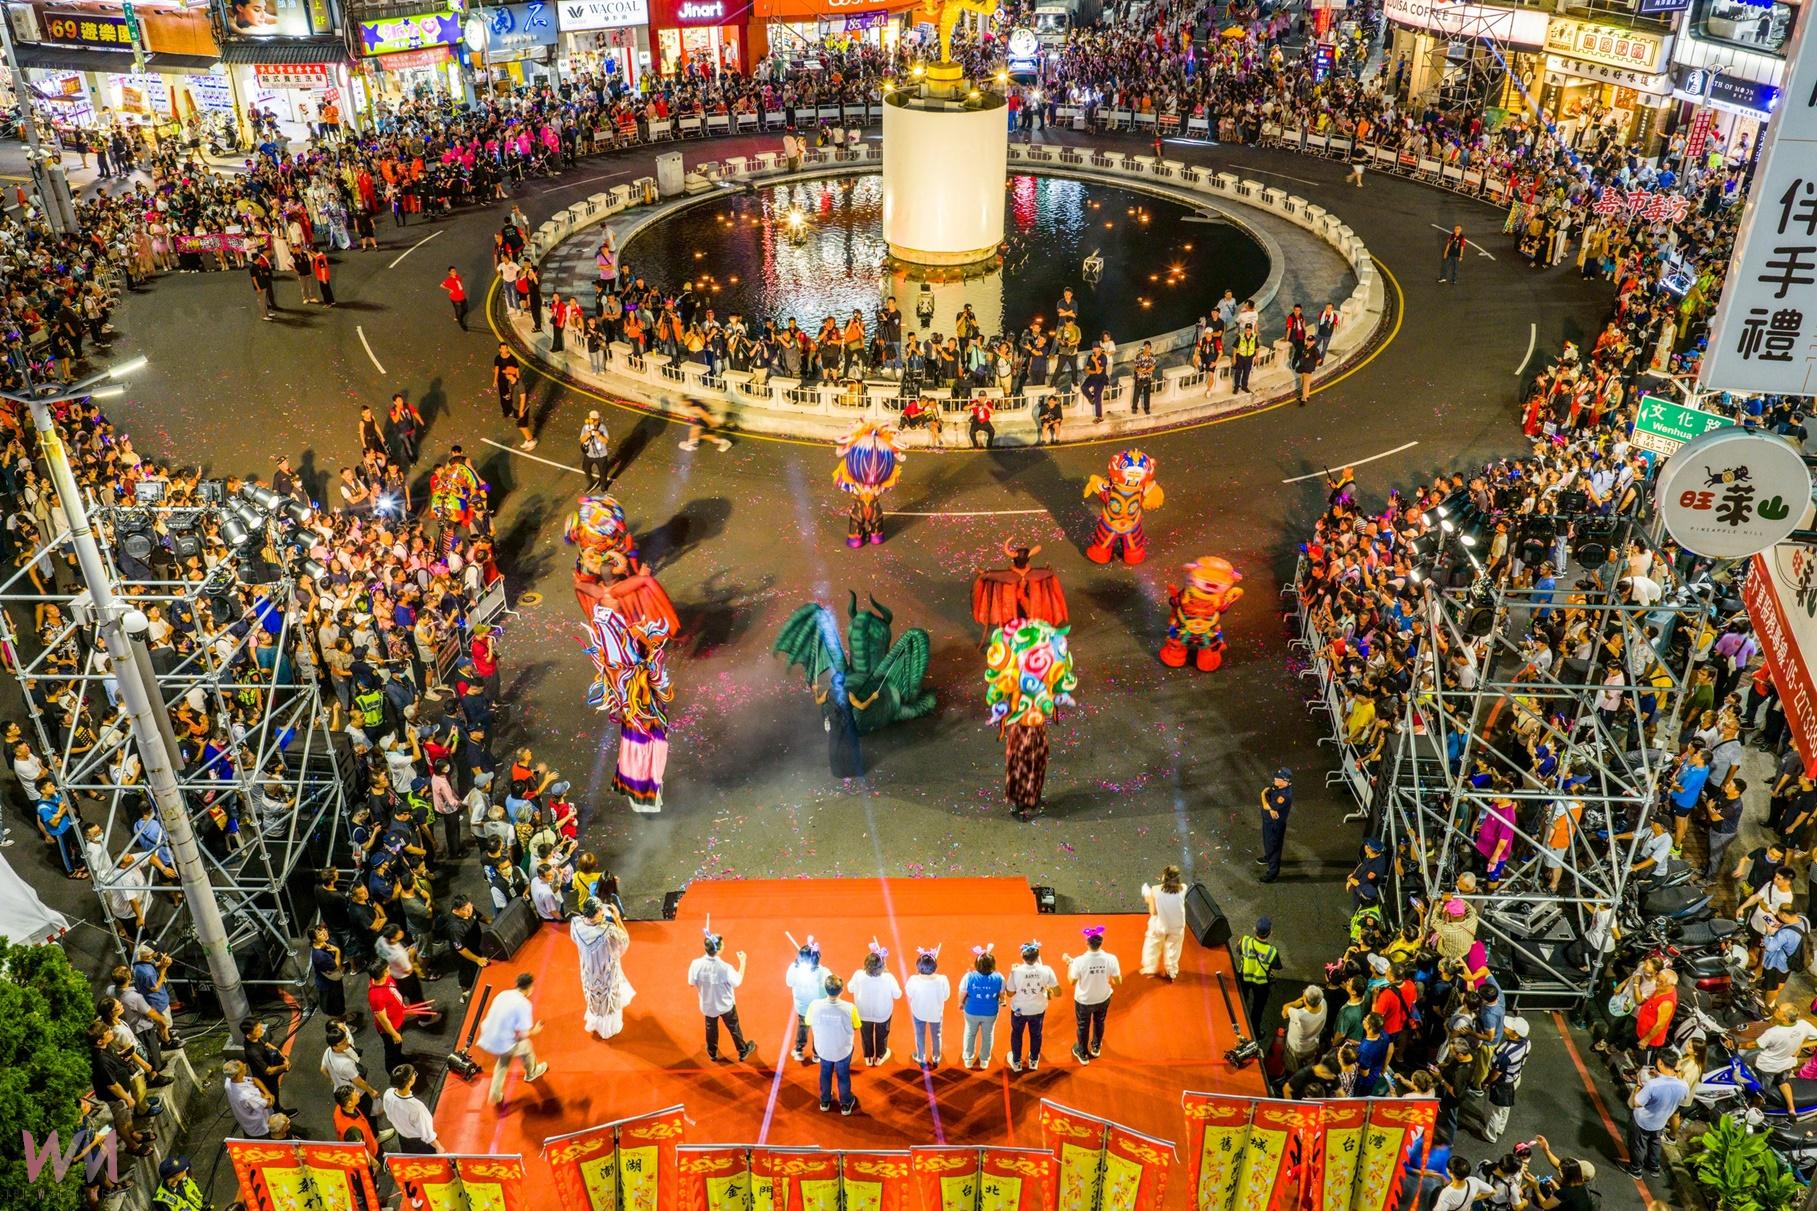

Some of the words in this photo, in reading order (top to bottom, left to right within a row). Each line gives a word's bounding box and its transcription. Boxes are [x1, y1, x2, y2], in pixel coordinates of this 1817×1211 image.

[589, 1, 641, 14] WACOAL
[678, 2, 723, 18] Jinart
[51, 19, 78, 38] 69
[314, 16, 326, 25] 2F
[1725, 83, 1735, 91] OF
[1736, 178, 1817, 362] 伴手禮
[1648, 403, 1723, 433] 文化路
[1652, 421, 1693, 440] Wenhua
[1680, 484, 1790, 527] 旺萊山
[1342, 1134, 1386, 1152] 台灣
[724, 1184, 773, 1200] 金門
[962, 1183, 1000, 1197] 台北
